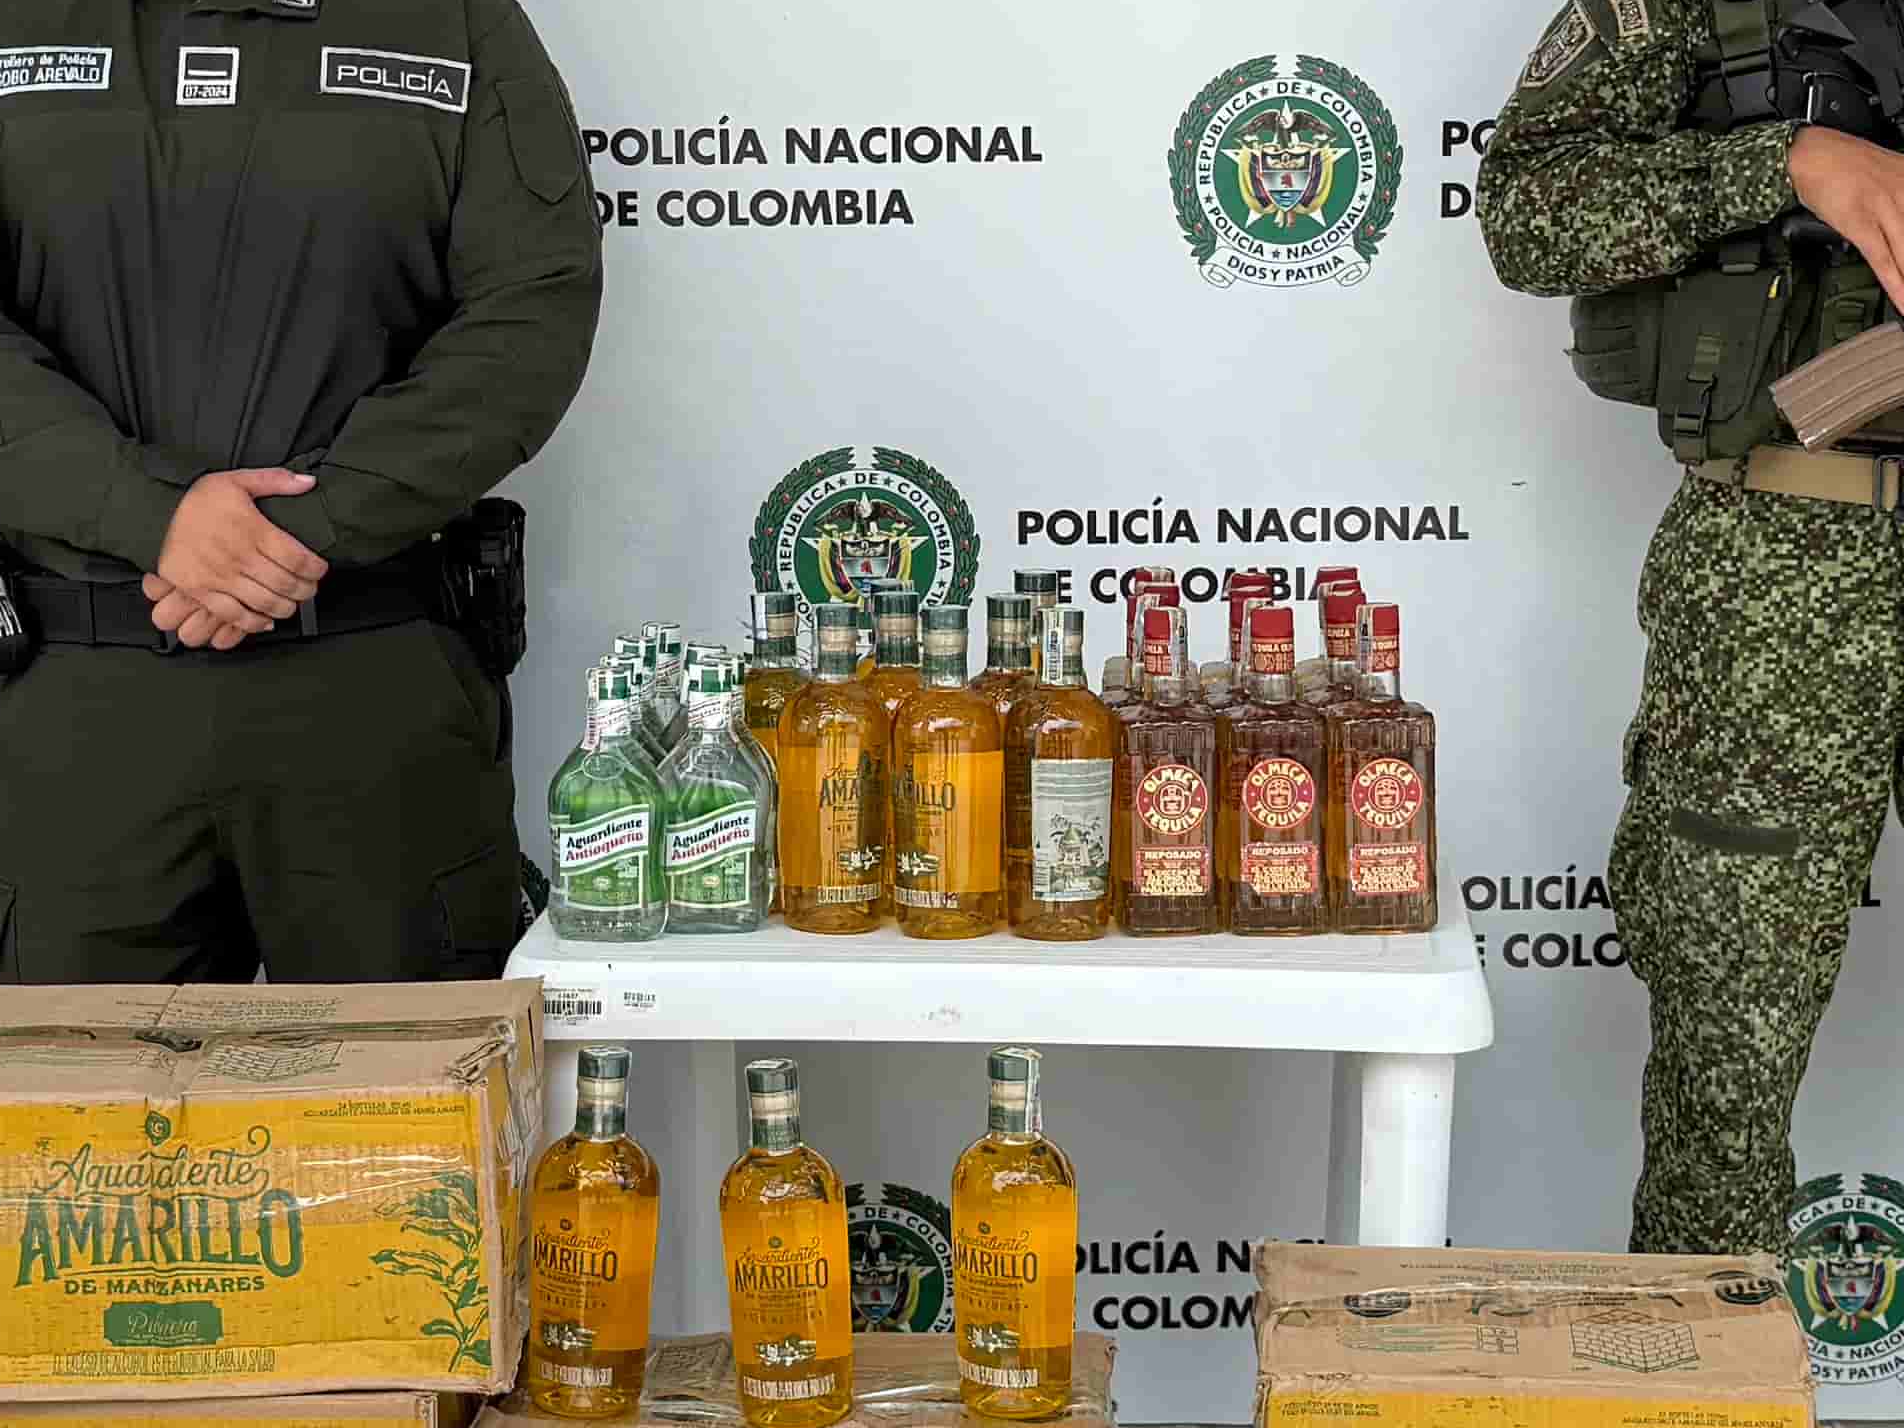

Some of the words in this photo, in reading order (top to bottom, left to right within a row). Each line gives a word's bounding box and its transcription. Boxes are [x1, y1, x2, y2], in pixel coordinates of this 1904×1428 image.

[34, 66, 100, 83] AREVALO
[337, 66, 455, 100] POLICÍA
[580, 116, 769, 166] POLICÍA
[785, 125, 1043, 165] NACIONAL
[1199, 91, 1253, 184] REPUBLICA
[1276, 81, 1302, 96] DE
[1320, 91, 1374, 183] COLOMBIA
[656, 188, 914, 227] COLOMBIA
[1209, 206, 1265, 256] POLICIA
[1288, 206, 1363, 260] NACIONAL
[1285, 257, 1344, 282] PATRIA
[1017, 496, 1201, 546] POLICÍA
[1217, 505, 1470, 543] NACIONAL
[1143, 768, 1199, 795] OLMECA
[1249, 759, 1308, 789] OLMECA
[1358, 759, 1416, 789] OLMECA
[671, 813, 752, 848] Aguardiente
[1144, 806, 1202, 832] TEQUILA
[1250, 801, 1309, 829] TEQUILA
[1358, 801, 1418, 830] TEQUILA
[562, 829, 646, 865] Antioqueño
[563, 816, 645, 850] Aguardiente
[669, 826, 752, 863] Antioqueño
[1144, 849, 1202, 862] REPOSADO
[1251, 844, 1309, 858] REPOSADO
[1360, 844, 1418, 858] REPOSADO
[1461, 864, 1612, 913] OLICÍA
[1501, 931, 1624, 970] COLO
[35, 1125, 272, 1196] Aguardiente
[16, 1188, 304, 1289] AMARILLO
[1076, 1226, 1202, 1278] LICÍA
[63, 1276, 96, 1296] DE
[104, 1274, 265, 1296] MANZANARES
[734, 1258, 830, 1294] AMARILLO
[1095, 1293, 1254, 1335] COLOM
